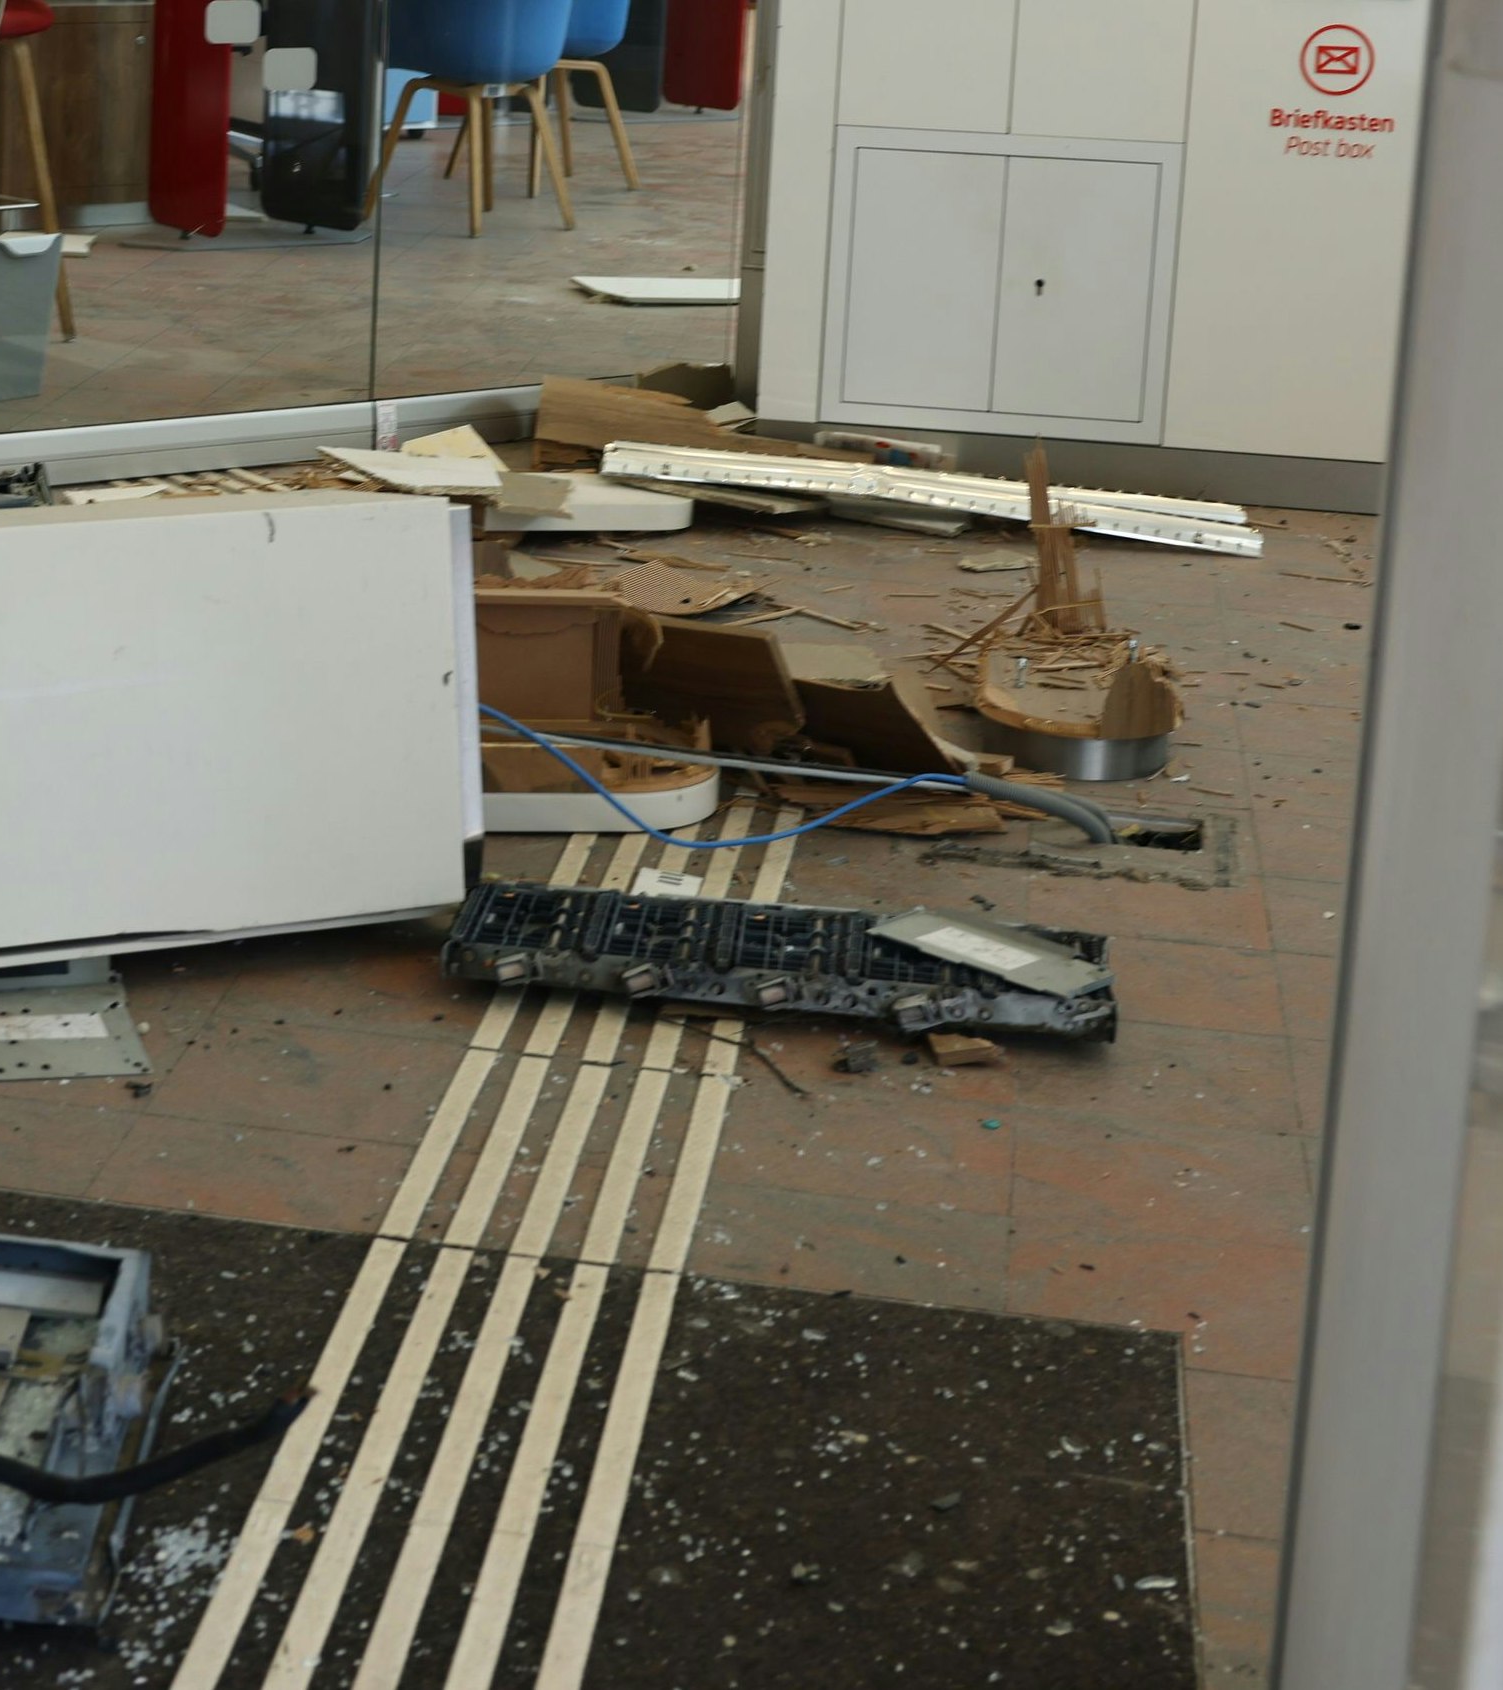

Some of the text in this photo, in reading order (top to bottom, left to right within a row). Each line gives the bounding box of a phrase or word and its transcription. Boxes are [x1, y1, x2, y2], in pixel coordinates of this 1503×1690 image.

[1269, 108, 1395, 133] Briefkasten
[1284, 136, 1376, 159] Post box
